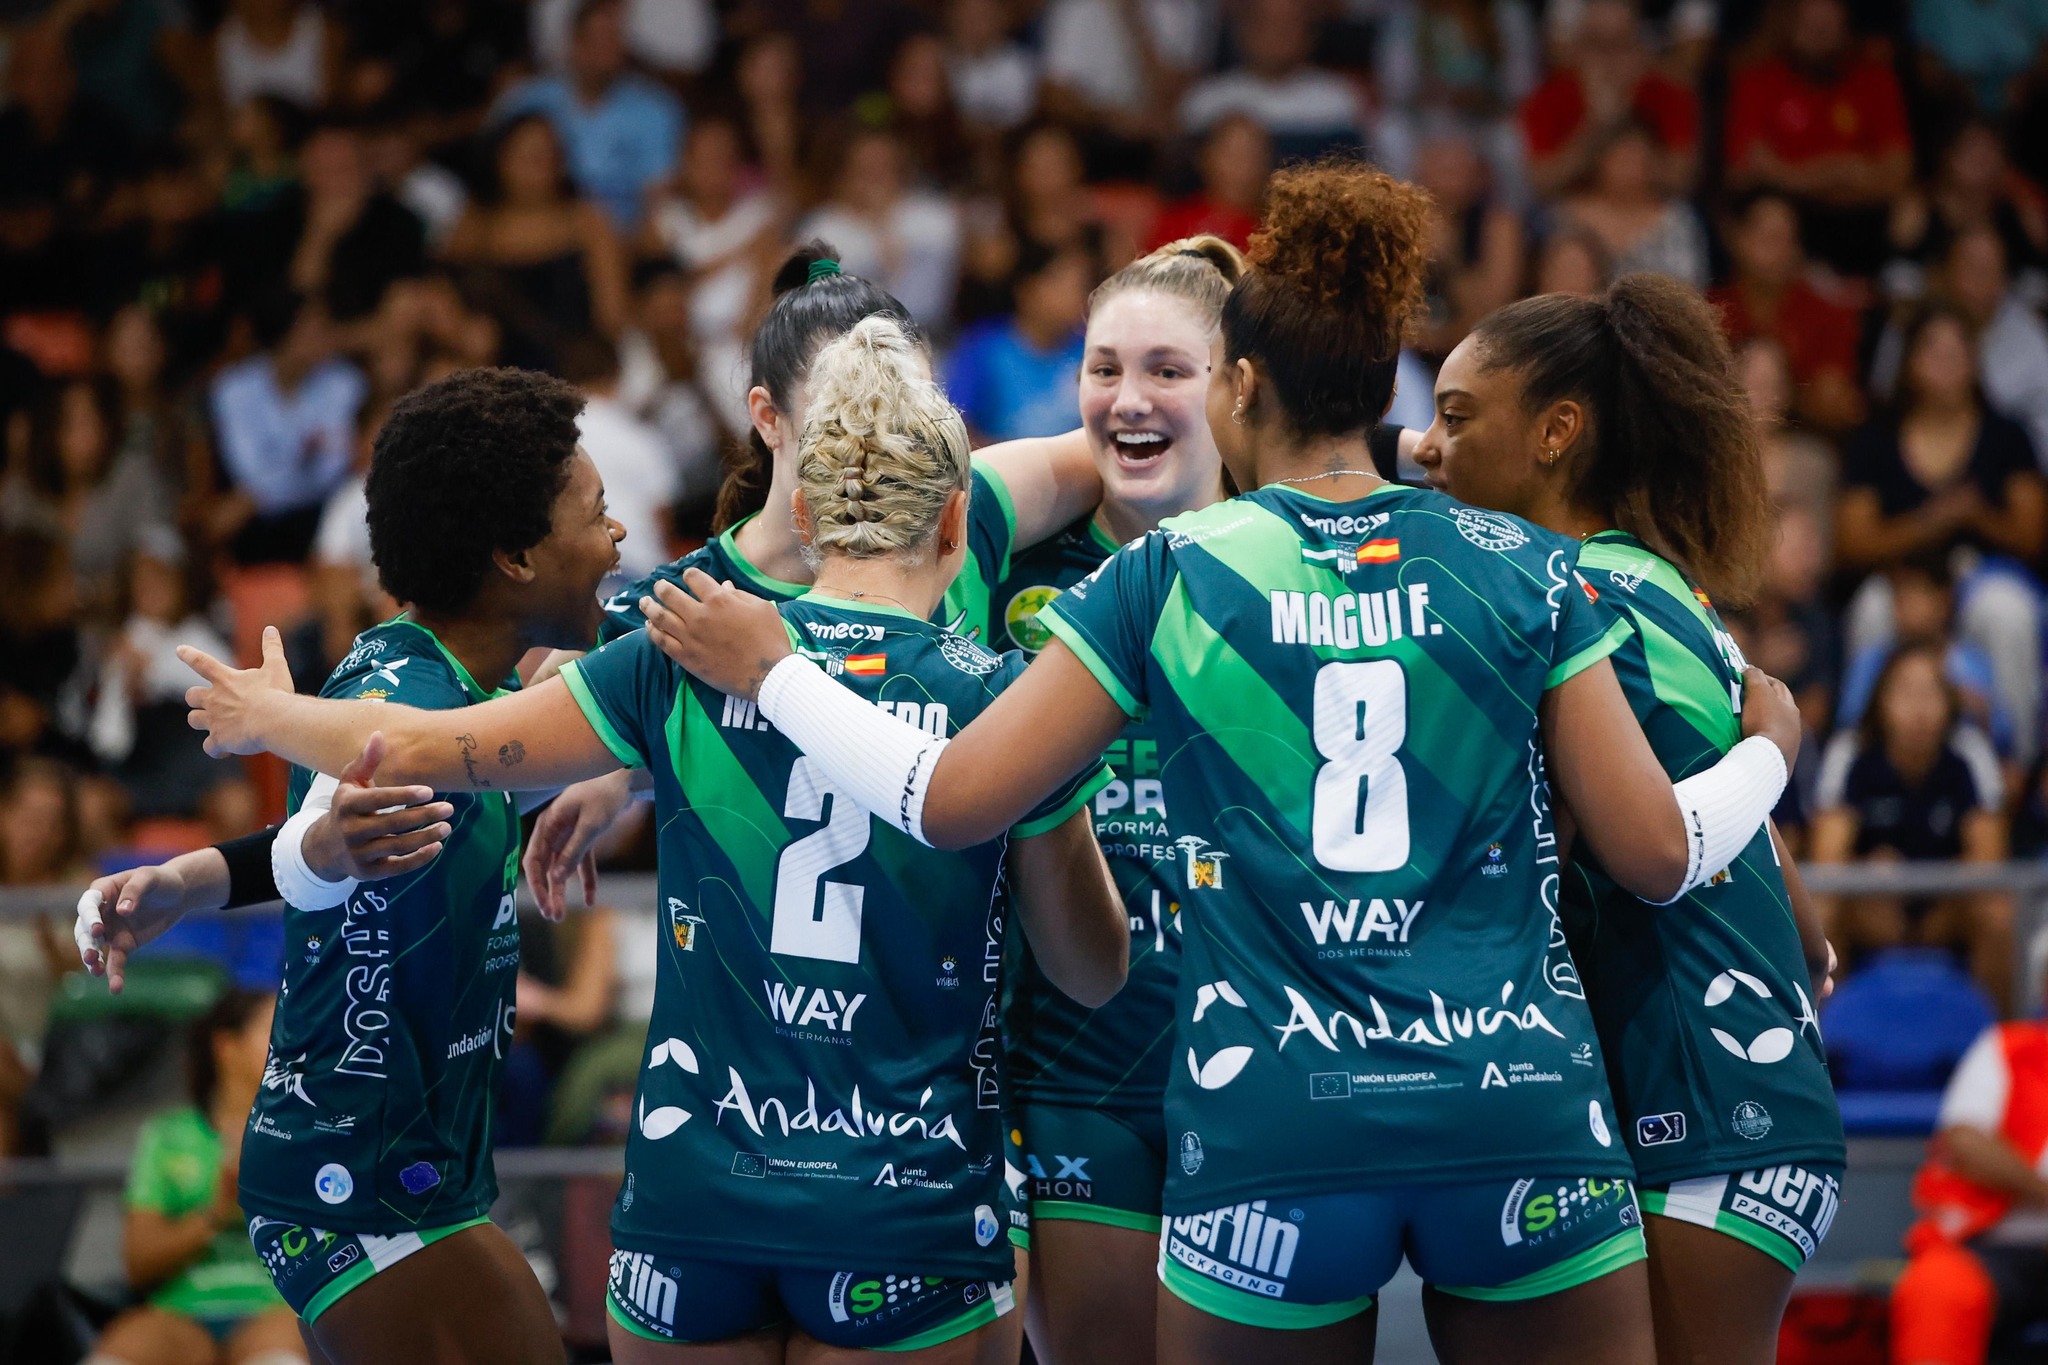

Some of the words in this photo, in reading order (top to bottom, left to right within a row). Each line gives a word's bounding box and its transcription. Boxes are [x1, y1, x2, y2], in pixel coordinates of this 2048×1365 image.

[1270, 588, 1402, 650] MAGUI
[1408, 583, 1444, 637] F.
[1313, 660, 1411, 873] 8
[1095, 778, 1168, 820] PR
[1096, 821, 1170, 838] FORMA
[769, 755, 871, 964] 2
[1101, 843, 1177, 861] PROFES
[1300, 898, 1425, 946] WAY
[1317, 949, 1345, 961] DOS
[1349, 946, 1413, 960] HERMANAS
[763, 978, 868, 1032] WAY
[1272, 980, 1567, 1053] Andalucía
[790, 1030, 853, 1047] HERMANAS
[1352, 1073, 1385, 1084] UNIÓN
[1386, 1071, 1437, 1083] EUROPEA
[1508, 1062, 1535, 1072] Junta
[1509, 1073, 1522, 1083] de
[1523, 1070, 1563, 1082] Andalucía
[711, 1065, 967, 1152] Andalucía
[768, 1158, 796, 1168] UNIÓN
[797, 1160, 839, 1171] EUROPEA
[901, 1166, 928, 1177] Junta
[901, 1177, 913, 1186] de
[913, 1178, 954, 1190] Andalucía
[1528, 1198, 1611, 1247] MEDICAL
[278, 1253, 312, 1289] DICAL
[1170, 1240, 1280, 1295] PACKAGING
